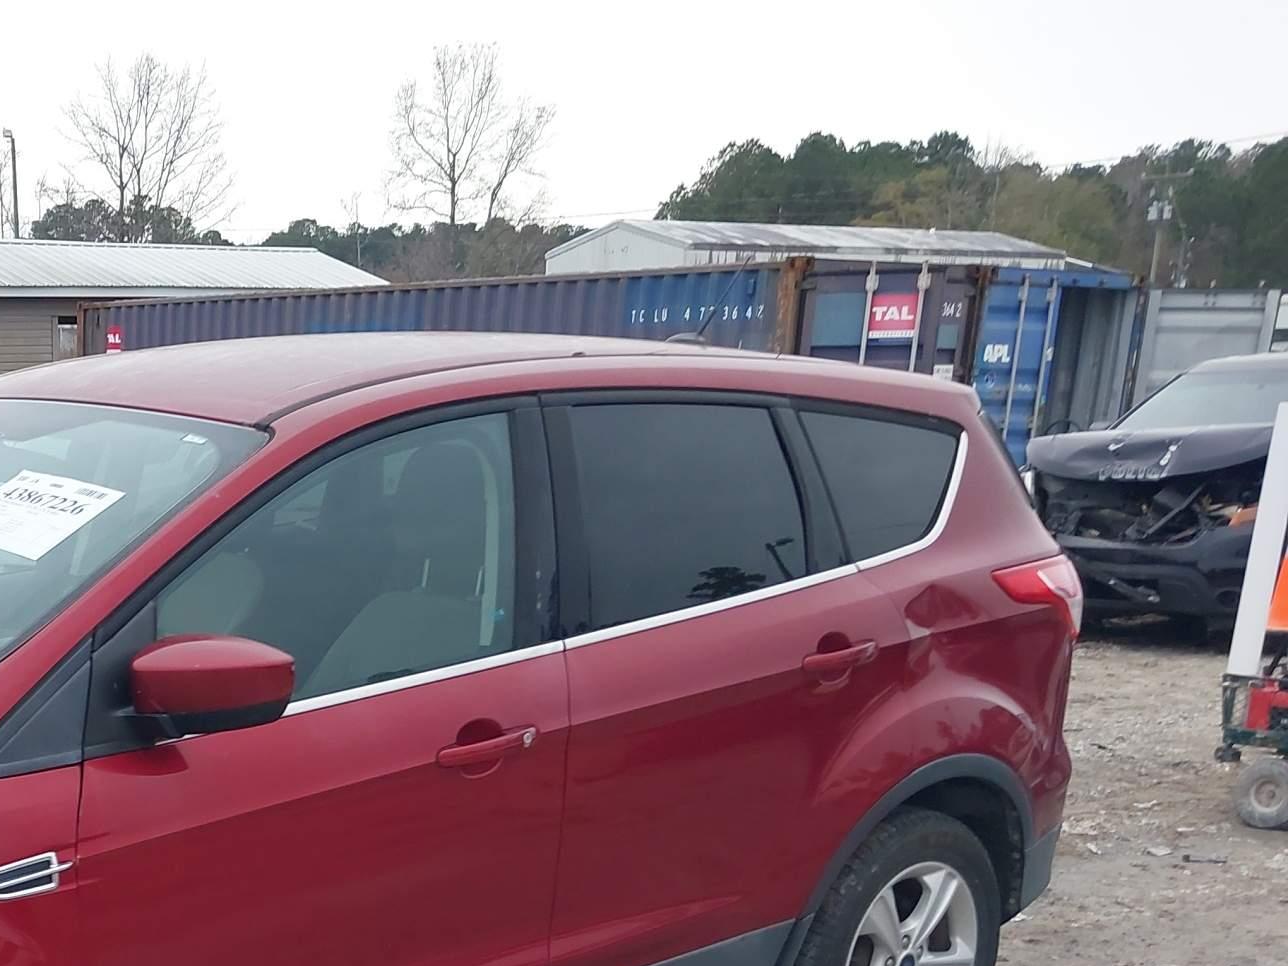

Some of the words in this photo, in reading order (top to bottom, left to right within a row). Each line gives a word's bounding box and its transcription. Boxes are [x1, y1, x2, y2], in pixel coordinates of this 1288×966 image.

[872, 305, 915, 321] TAL
[983, 343, 1010, 363] APL
[2, 487, 89, 515] 43867226
